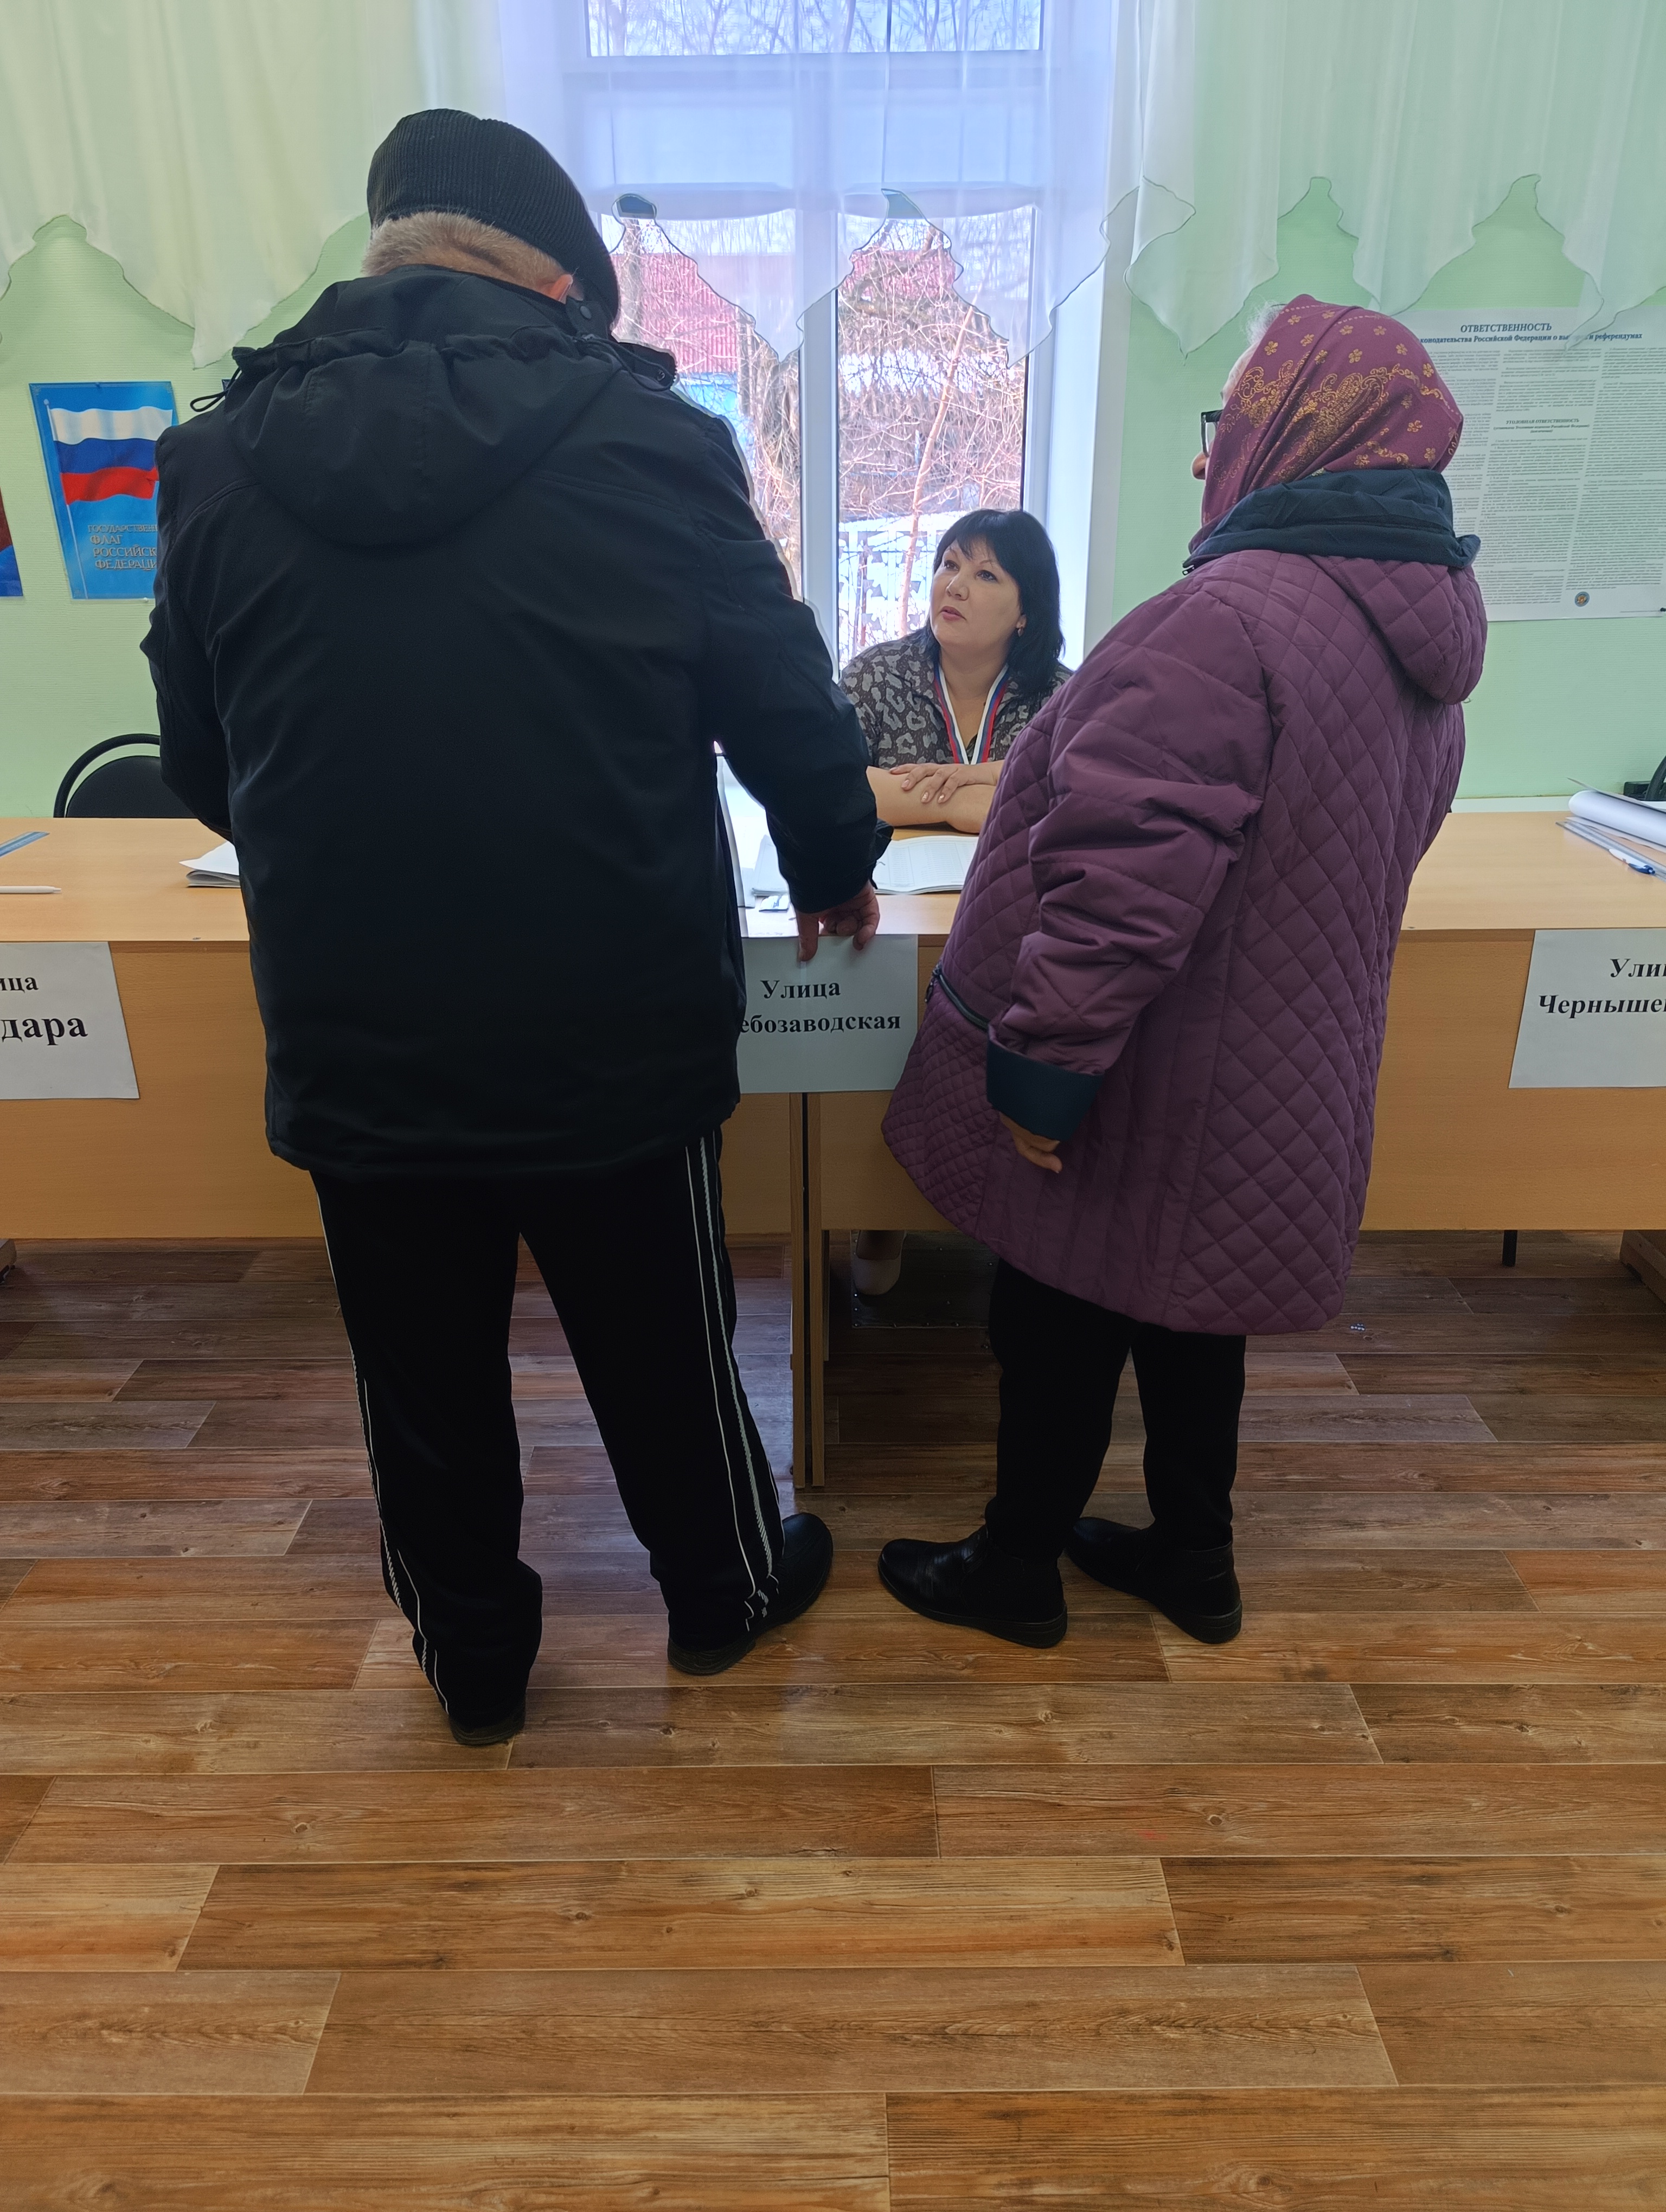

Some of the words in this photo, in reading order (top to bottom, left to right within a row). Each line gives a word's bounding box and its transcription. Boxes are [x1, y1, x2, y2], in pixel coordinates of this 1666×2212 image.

[1460, 323, 1552, 333] ОТВЕТСТВЕННОСТЬ
[1514, 334, 1552, 343] Федерации
[1593, 333, 1642, 342] референдумах
[90, 535, 123, 545] ФЛАГ
[93, 544, 157, 558] РОССИЙСК
[760, 980, 841, 999] Улица
[1538, 994, 1666, 1019] Черныше
[0, 1018, 88, 1046] дара
